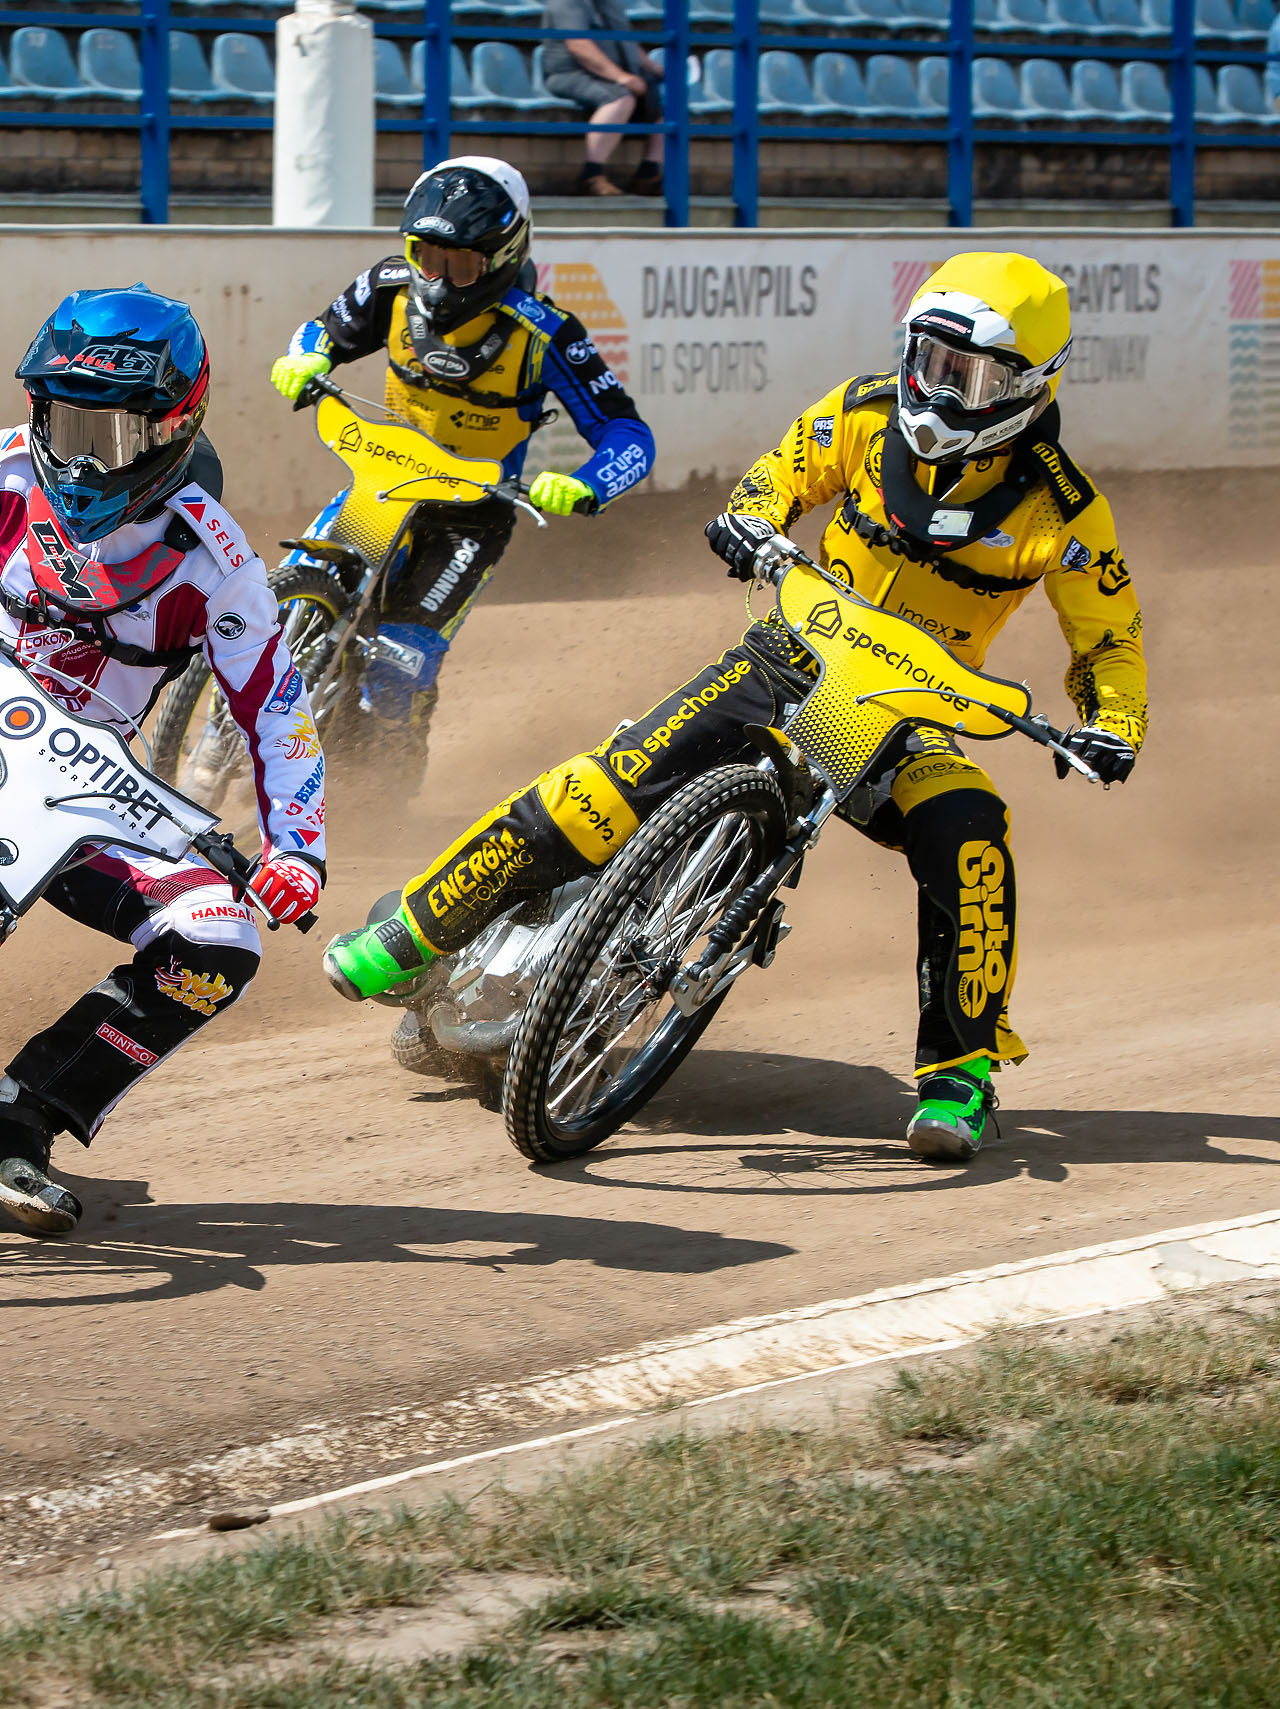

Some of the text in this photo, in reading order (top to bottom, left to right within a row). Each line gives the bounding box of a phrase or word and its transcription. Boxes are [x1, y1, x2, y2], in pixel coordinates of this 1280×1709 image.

[642, 265, 817, 318] DAUGAVPILS
[1054, 263, 1160, 313] GAVPILS
[74, 354, 116, 371] SELS
[640, 342, 769, 395] IR SPORTS
[364, 441, 461, 488] spechouse
[206, 519, 245, 568] SELS
[898, 602, 953, 637] Imex
[843, 625, 970, 712] spechouse
[643, 660, 752, 754] spechouse
[49, 727, 174, 831] OPTIBET
[294, 756, 325, 804] BERNE
[907, 762, 957, 783] Imex
[565, 773, 615, 844] Kubota
[269, 865, 312, 903] SCOTT
[100, 1025, 155, 1066] PRINTSOL
